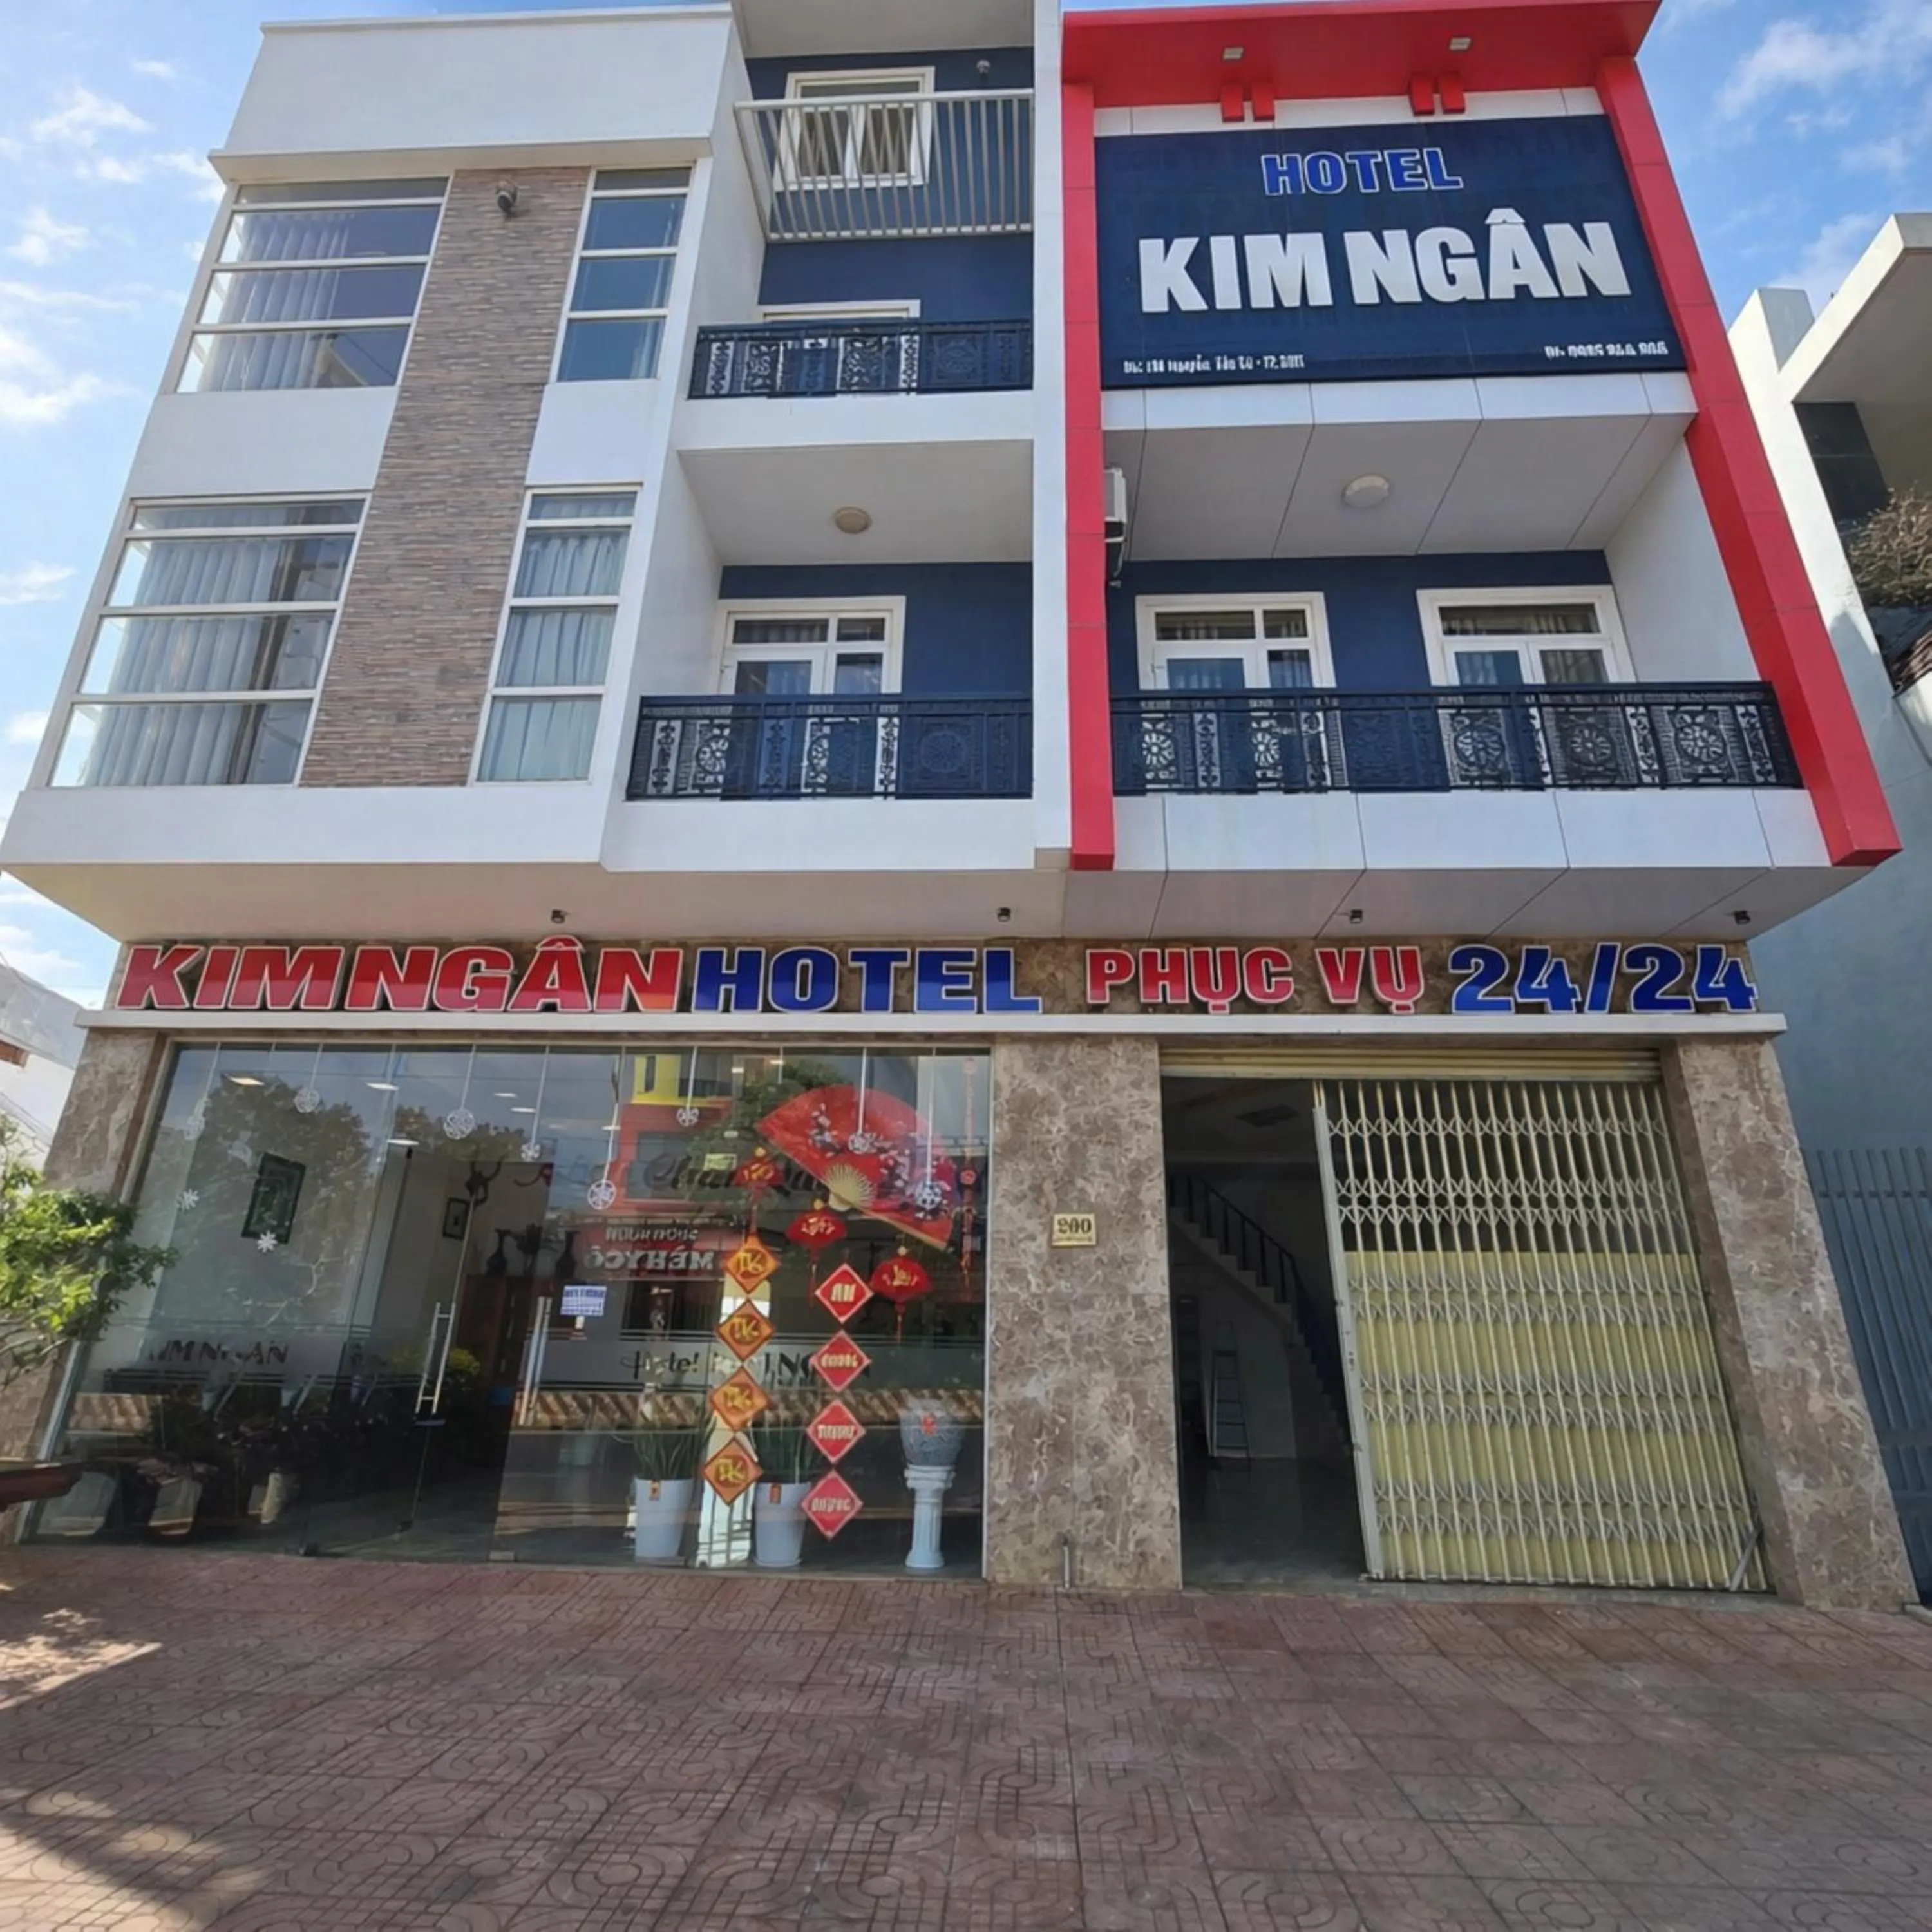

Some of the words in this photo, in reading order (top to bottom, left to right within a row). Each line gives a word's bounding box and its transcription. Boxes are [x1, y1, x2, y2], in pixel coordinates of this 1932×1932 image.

[1261, 147, 1464, 196] HOTEL
[1138, 232, 1334, 313] KIM
[1343, 207, 1632, 305] NGÂN
[690, 946, 1043, 1014] HOTEL
[1085, 947, 1294, 1014] PHỤC
[1317, 945, 1425, 1014] VỤ
[1448, 942, 1757, 1014] 24/24
[1057, 1217, 1093, 1235] 200
